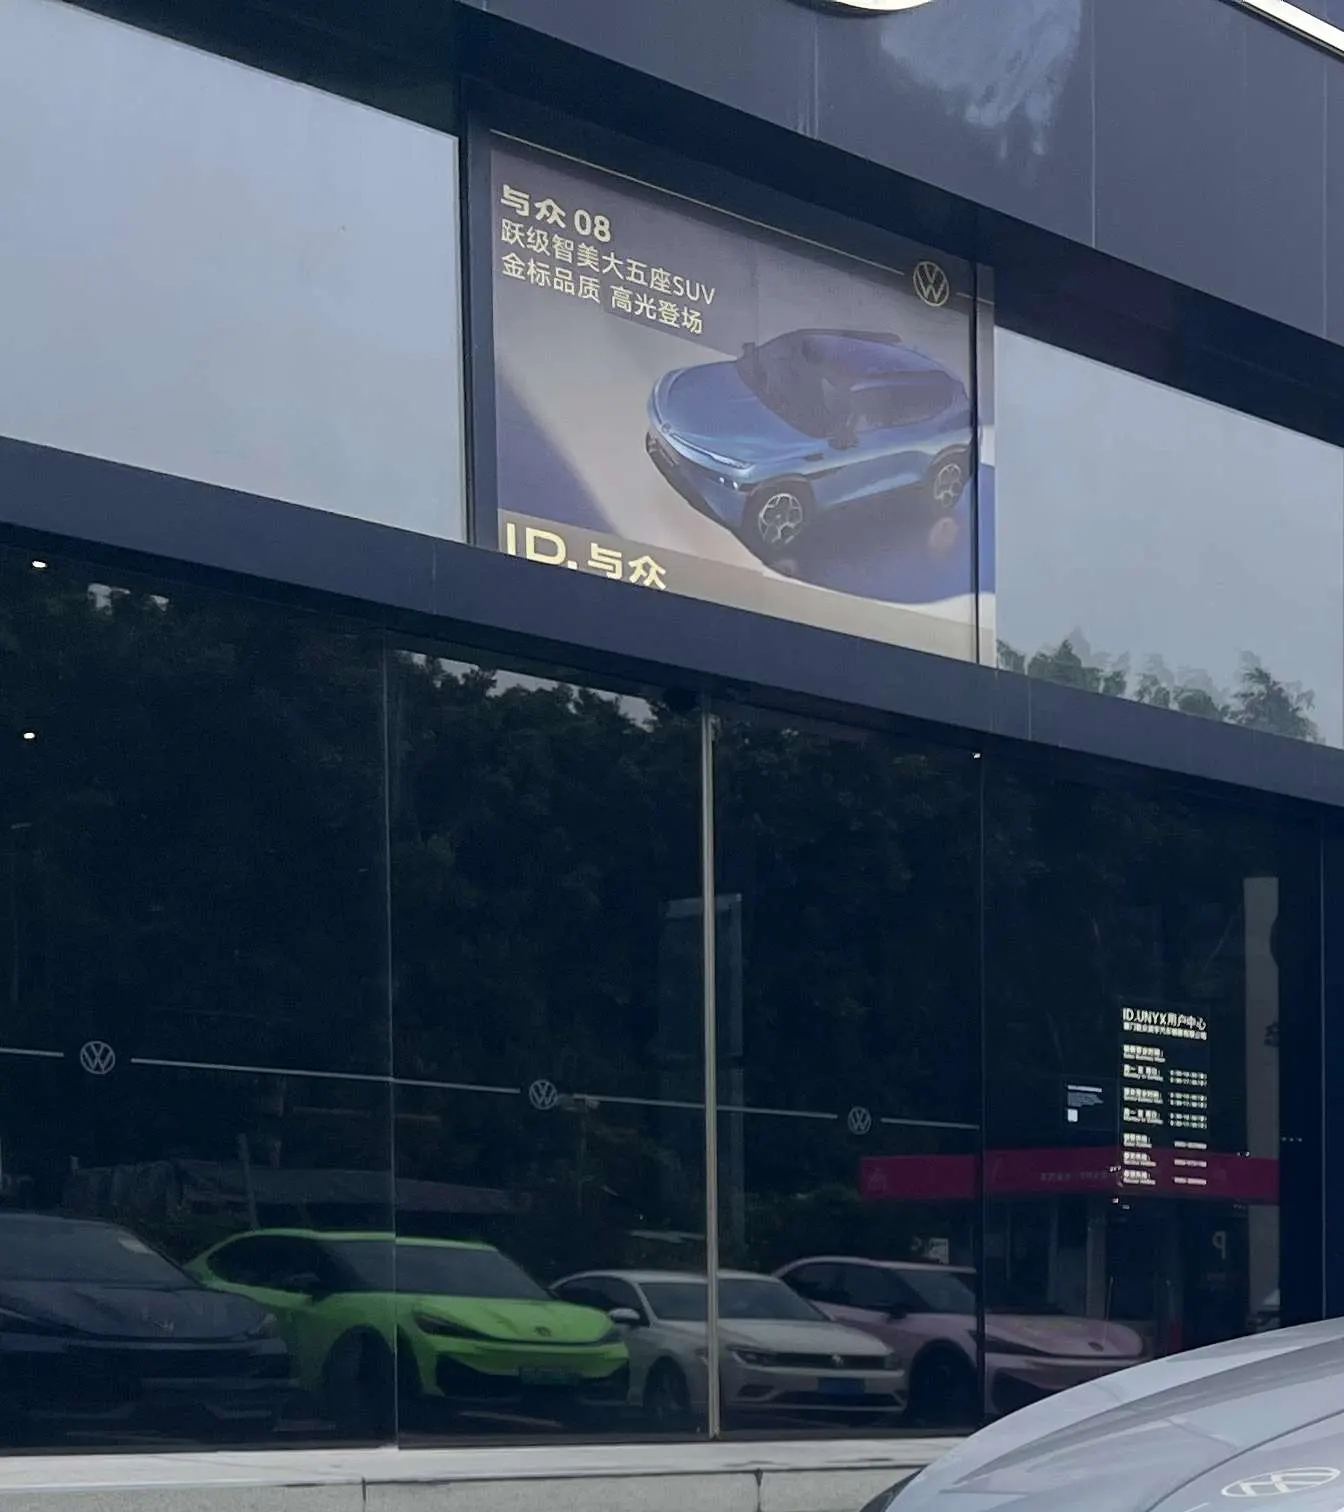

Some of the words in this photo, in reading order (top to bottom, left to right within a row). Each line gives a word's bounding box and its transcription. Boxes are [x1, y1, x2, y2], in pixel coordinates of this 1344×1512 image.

[501, 218, 716, 305] 跃级智美大五座SUV
[501, 252, 601, 305] 金标品质
[609, 284, 704, 335] 高光登场
